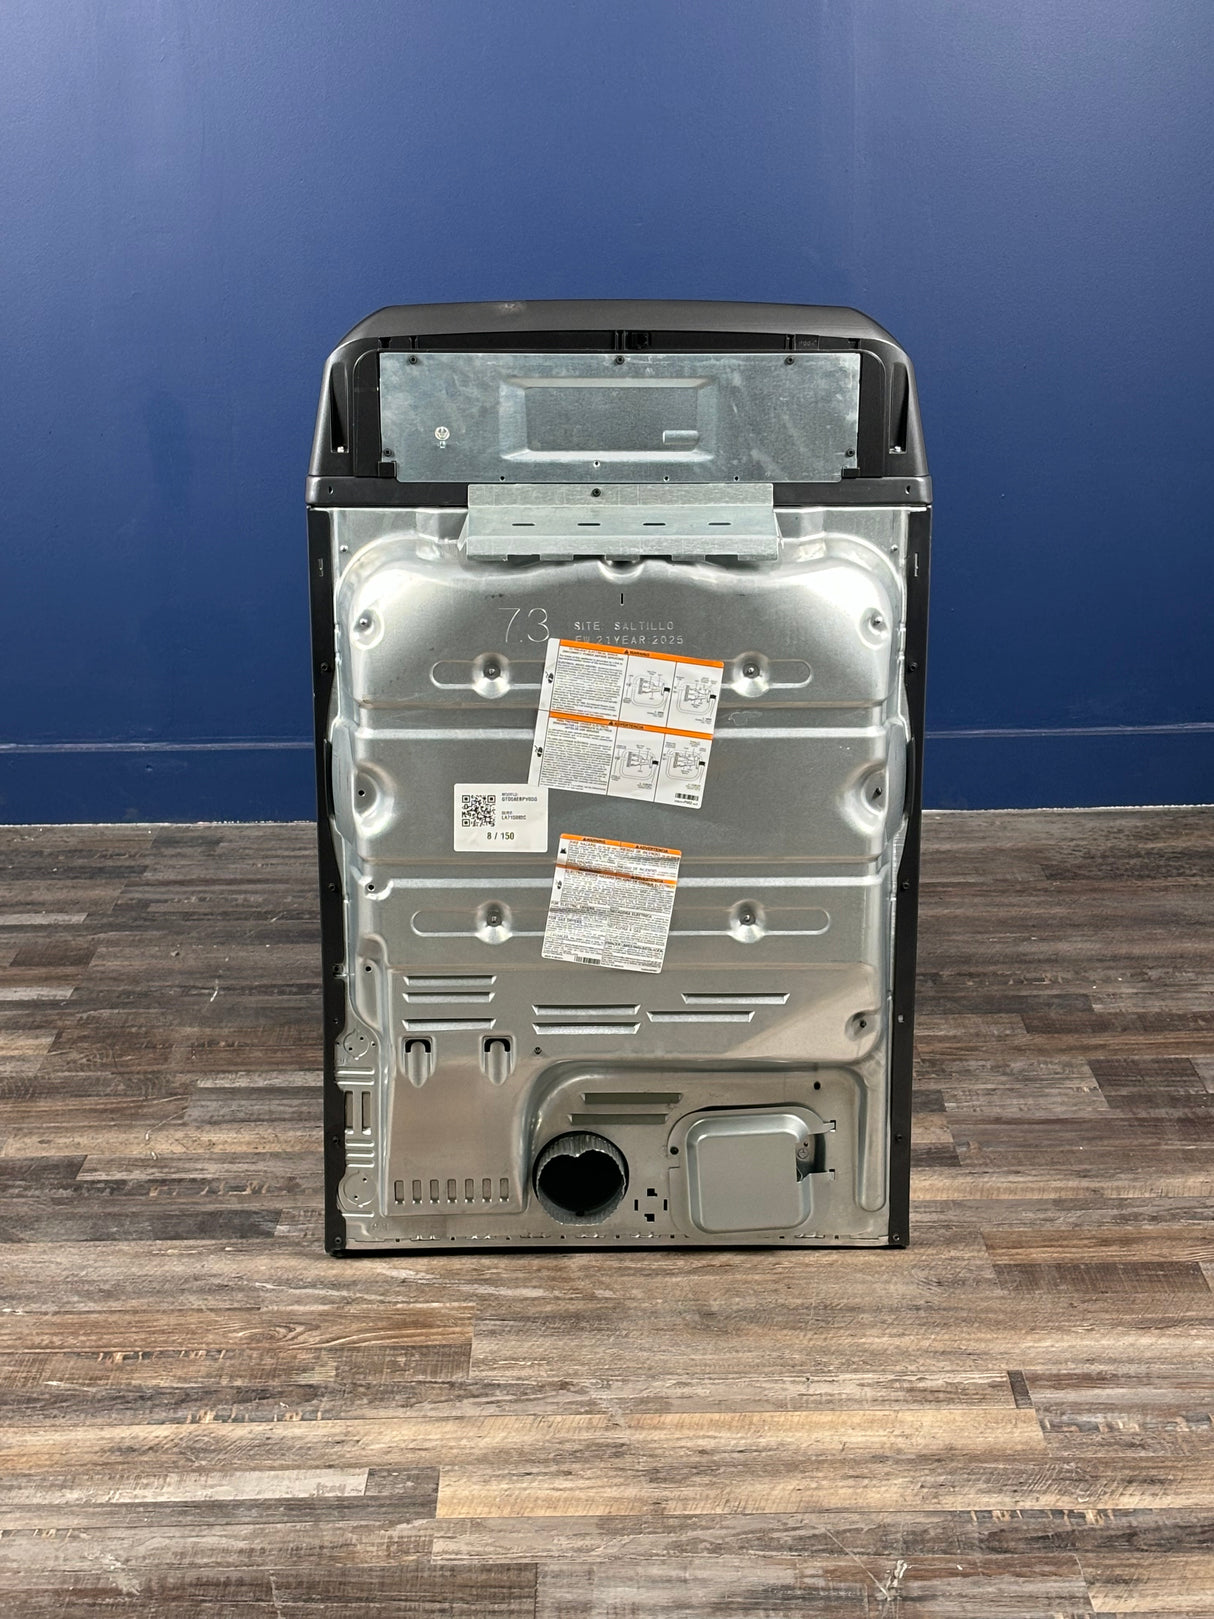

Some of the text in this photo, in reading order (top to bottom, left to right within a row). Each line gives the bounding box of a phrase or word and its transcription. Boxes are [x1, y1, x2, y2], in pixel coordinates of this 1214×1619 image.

[498, 607, 550, 642] 7.3
[614, 621, 674, 631] SALTILLO
[486, 832, 492, 840] 8
[500, 832, 515, 840] 150
